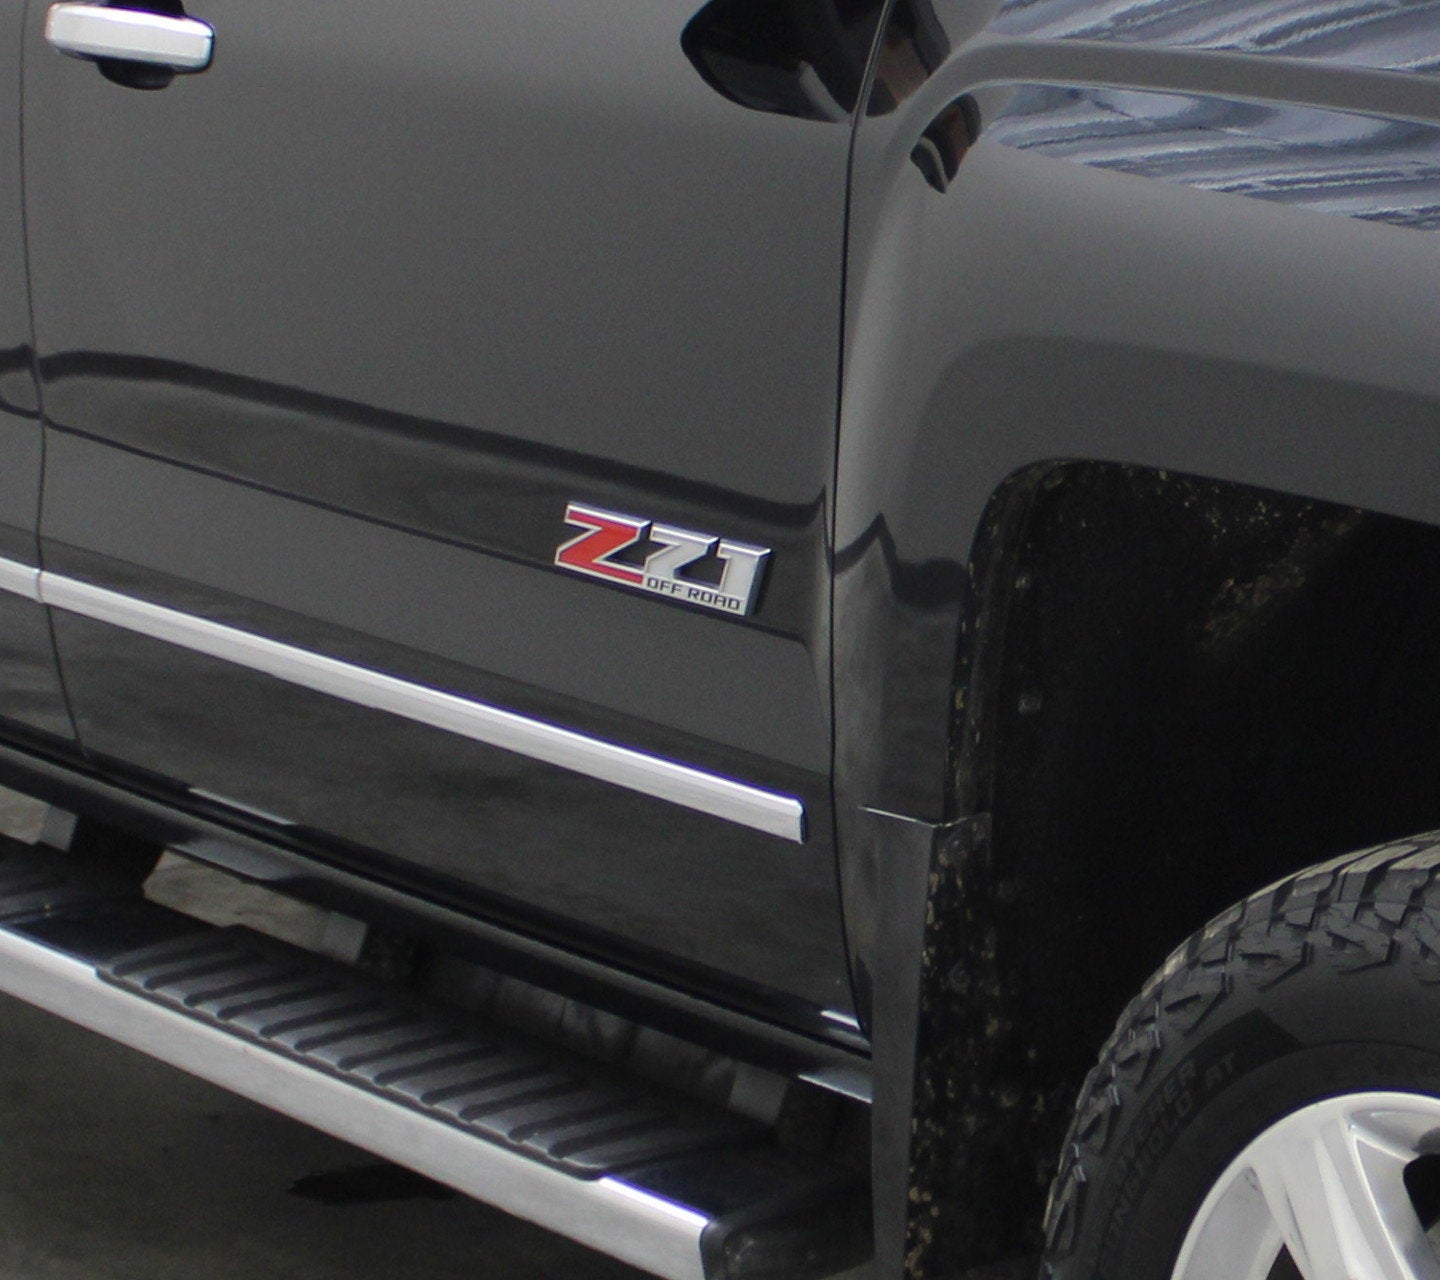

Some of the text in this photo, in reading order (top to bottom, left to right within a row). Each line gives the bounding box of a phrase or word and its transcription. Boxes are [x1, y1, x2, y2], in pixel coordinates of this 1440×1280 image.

[554, 500, 771, 616] Z71
[646, 578, 742, 610] OFF ROAD
[1204, 1050, 1234, 1089] AT
